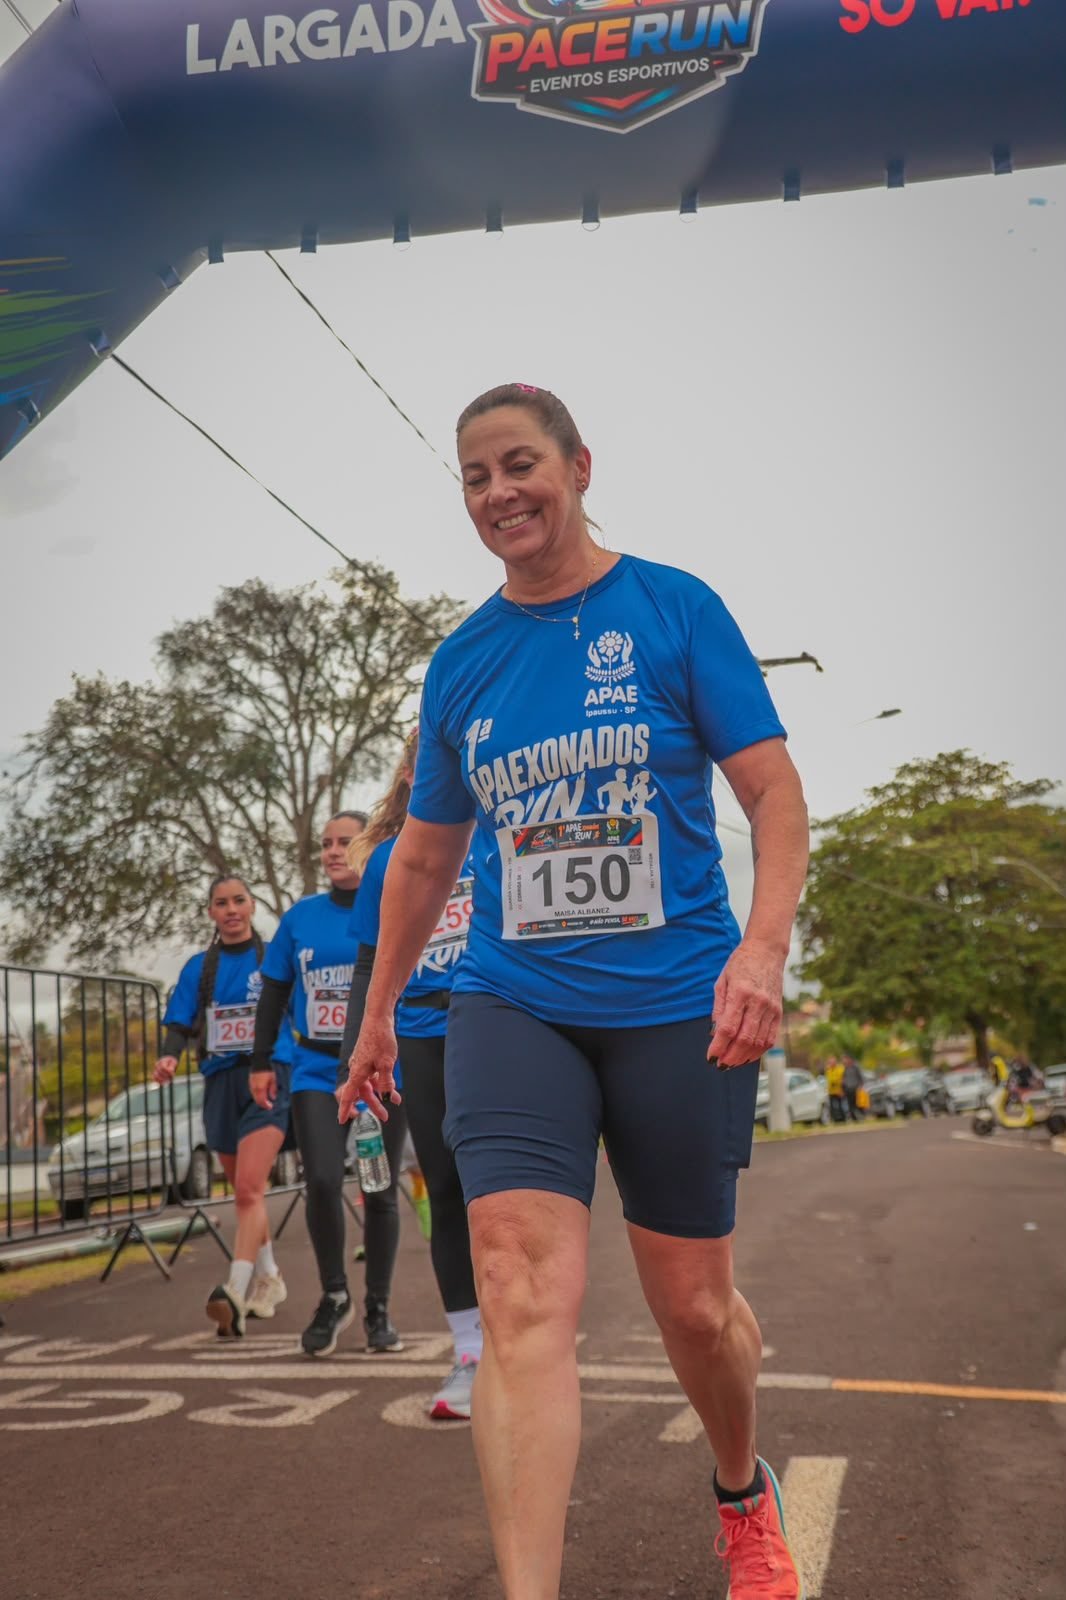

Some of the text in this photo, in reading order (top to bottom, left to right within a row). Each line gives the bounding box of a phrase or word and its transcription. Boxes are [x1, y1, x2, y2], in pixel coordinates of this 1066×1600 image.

[186, 0, 467, 76] LARGADA
[485, 2, 751, 84] PACERUN
[529, 57, 710, 94] EVENTOS ESPORTIVOS
[584, 685, 638, 707] APAE
[585, 708, 618, 718] Ipaussu
[624, 706, 637, 714] SP
[469, 723, 650, 815] APAEXONADOS
[532, 853, 631, 907] 150
[577, 907, 610, 915] ALBANEZ
